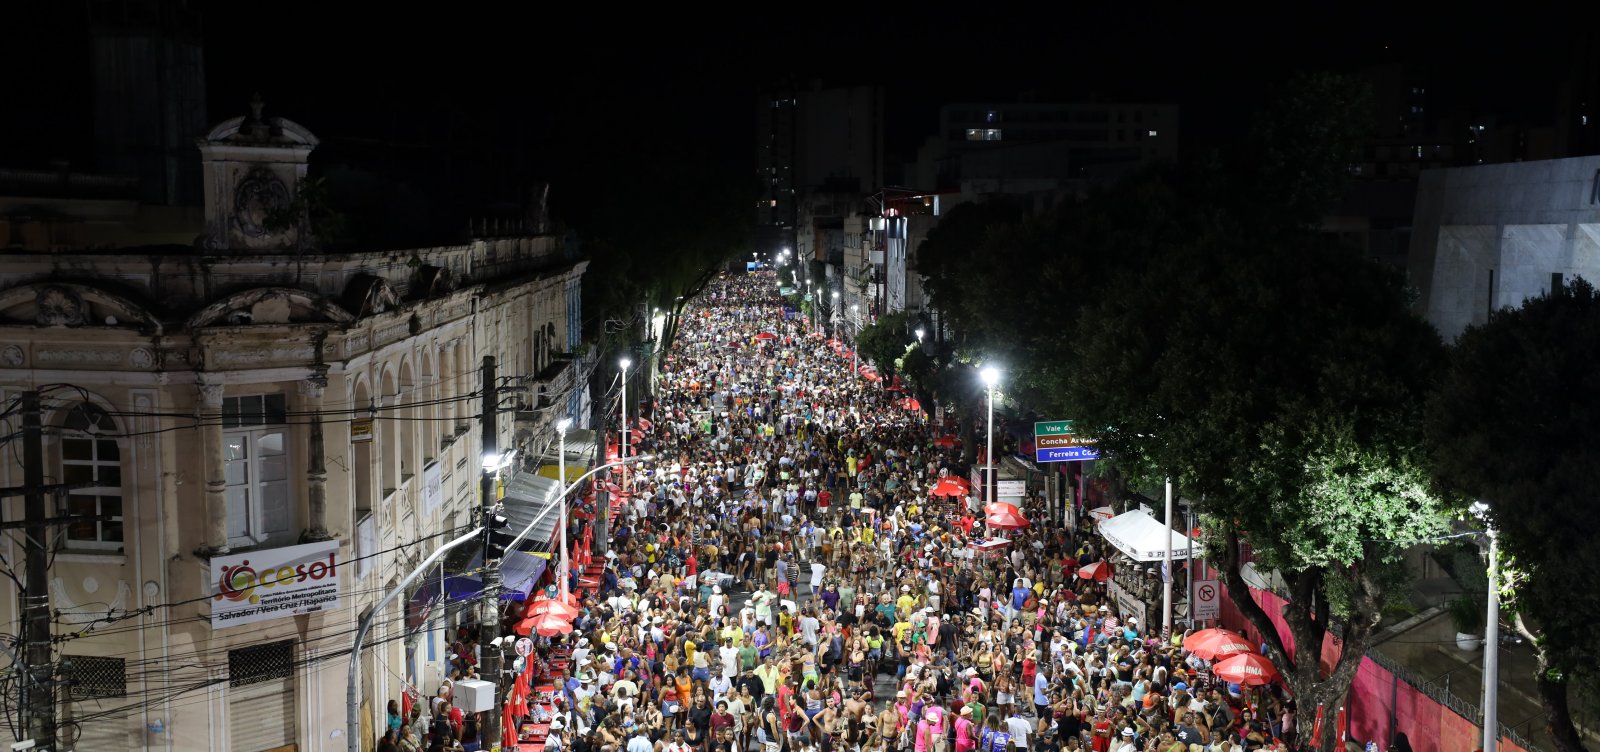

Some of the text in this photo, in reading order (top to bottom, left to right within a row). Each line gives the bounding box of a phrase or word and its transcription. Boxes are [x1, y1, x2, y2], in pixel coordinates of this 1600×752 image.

[260, 553, 336, 588] cesol
[260, 595, 290, 605] Território
[292, 588, 336, 600] Metropolitano
[219, 609, 255, 620] Salvador
[261, 605, 278, 613] Vera
[304, 595, 336, 607] Itaparica
[1221, 643, 1251, 652] BRAHMA
[1231, 666, 1262, 675] BRAHMA
